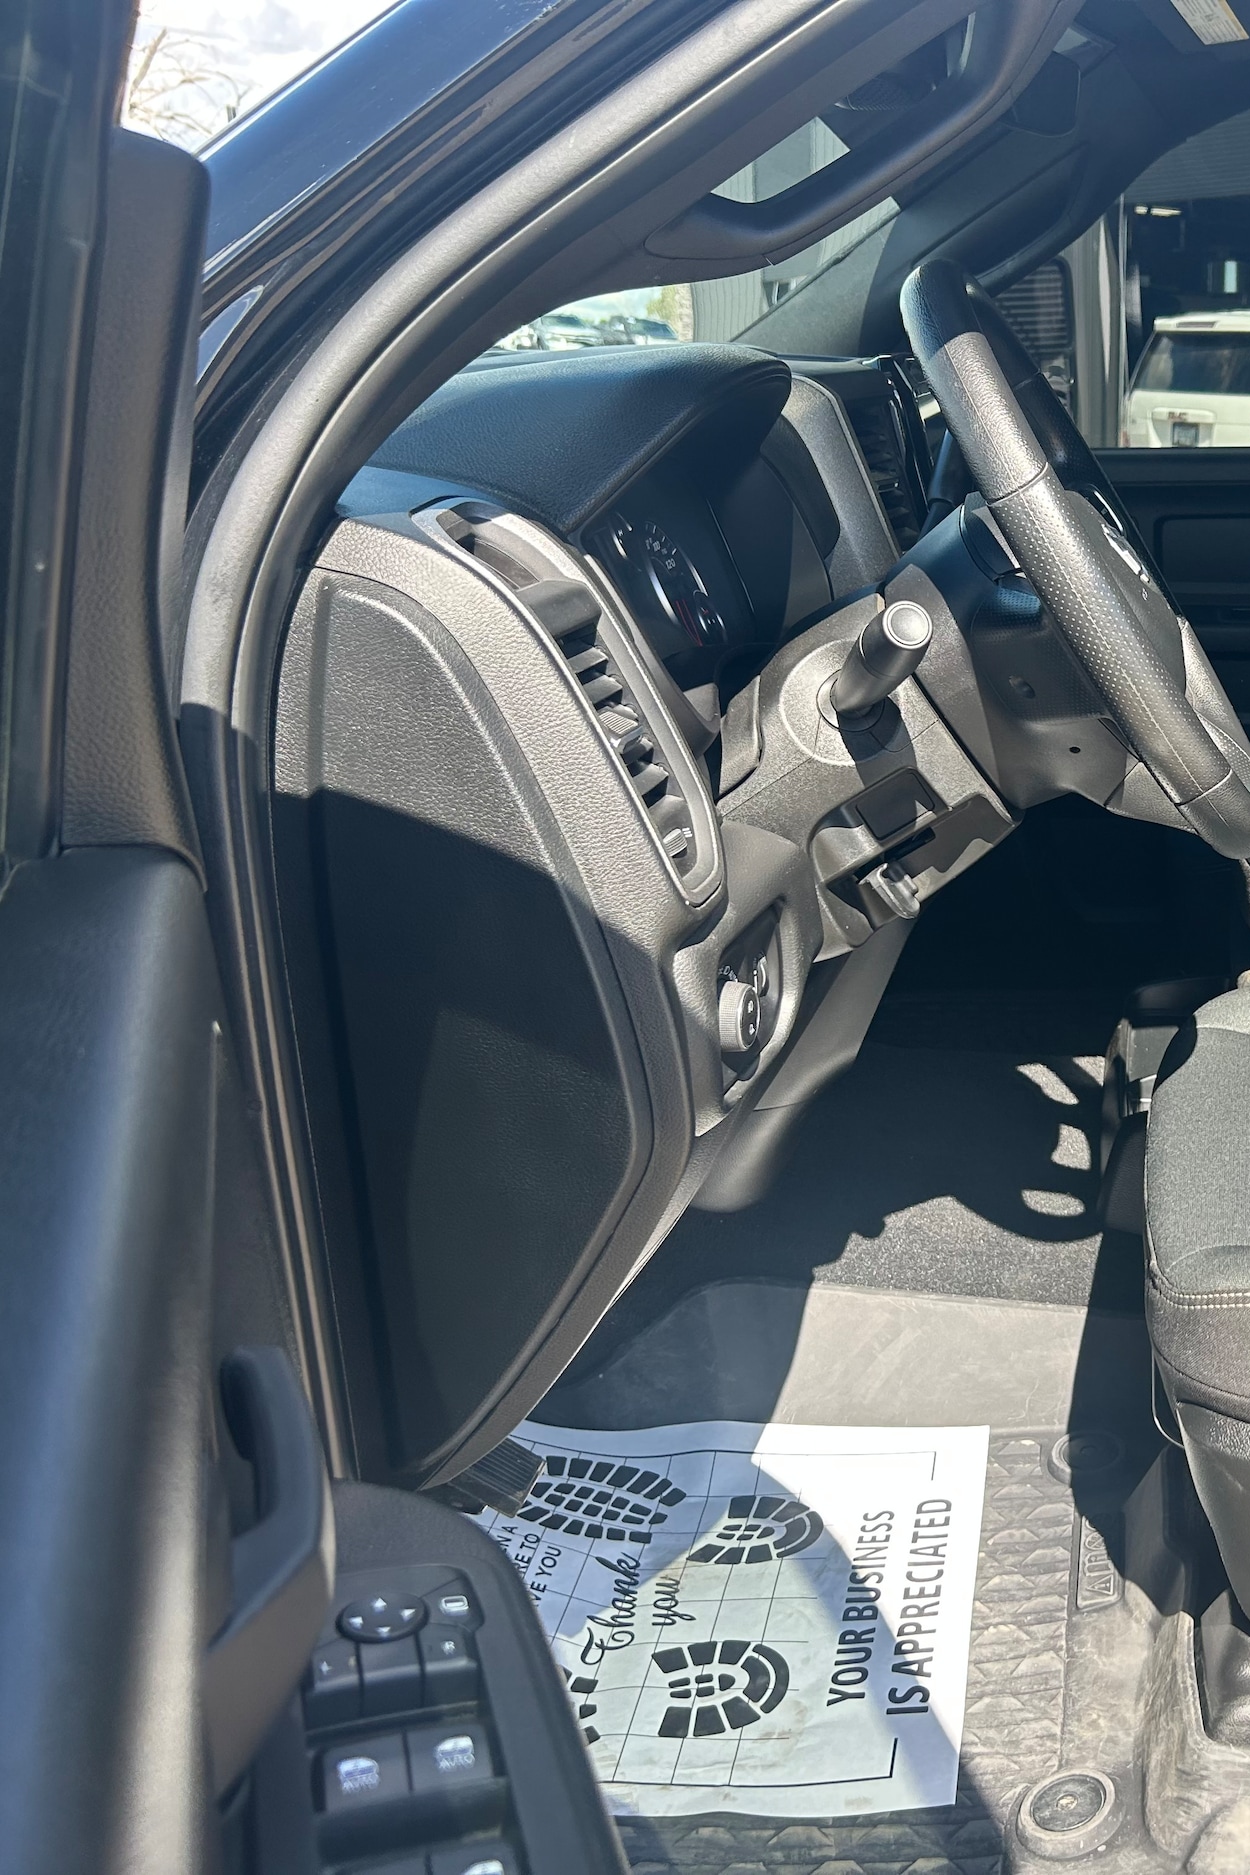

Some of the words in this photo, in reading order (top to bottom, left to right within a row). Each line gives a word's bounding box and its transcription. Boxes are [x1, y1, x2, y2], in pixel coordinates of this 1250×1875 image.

[665, 558, 676, 570] 120
[501, 1526, 518, 1535] A
[519, 1533, 541, 1551] TO
[535, 1545, 562, 1577] YOU
[842, 1510, 895, 1622] BUSINESS
[580, 1551, 641, 1665] Thank
[652, 1575, 697, 1626] you
[891, 1499, 952, 1678] APPRECIATED
[826, 1626, 876, 1706] YOUR
[886, 1684, 930, 1715] IS
